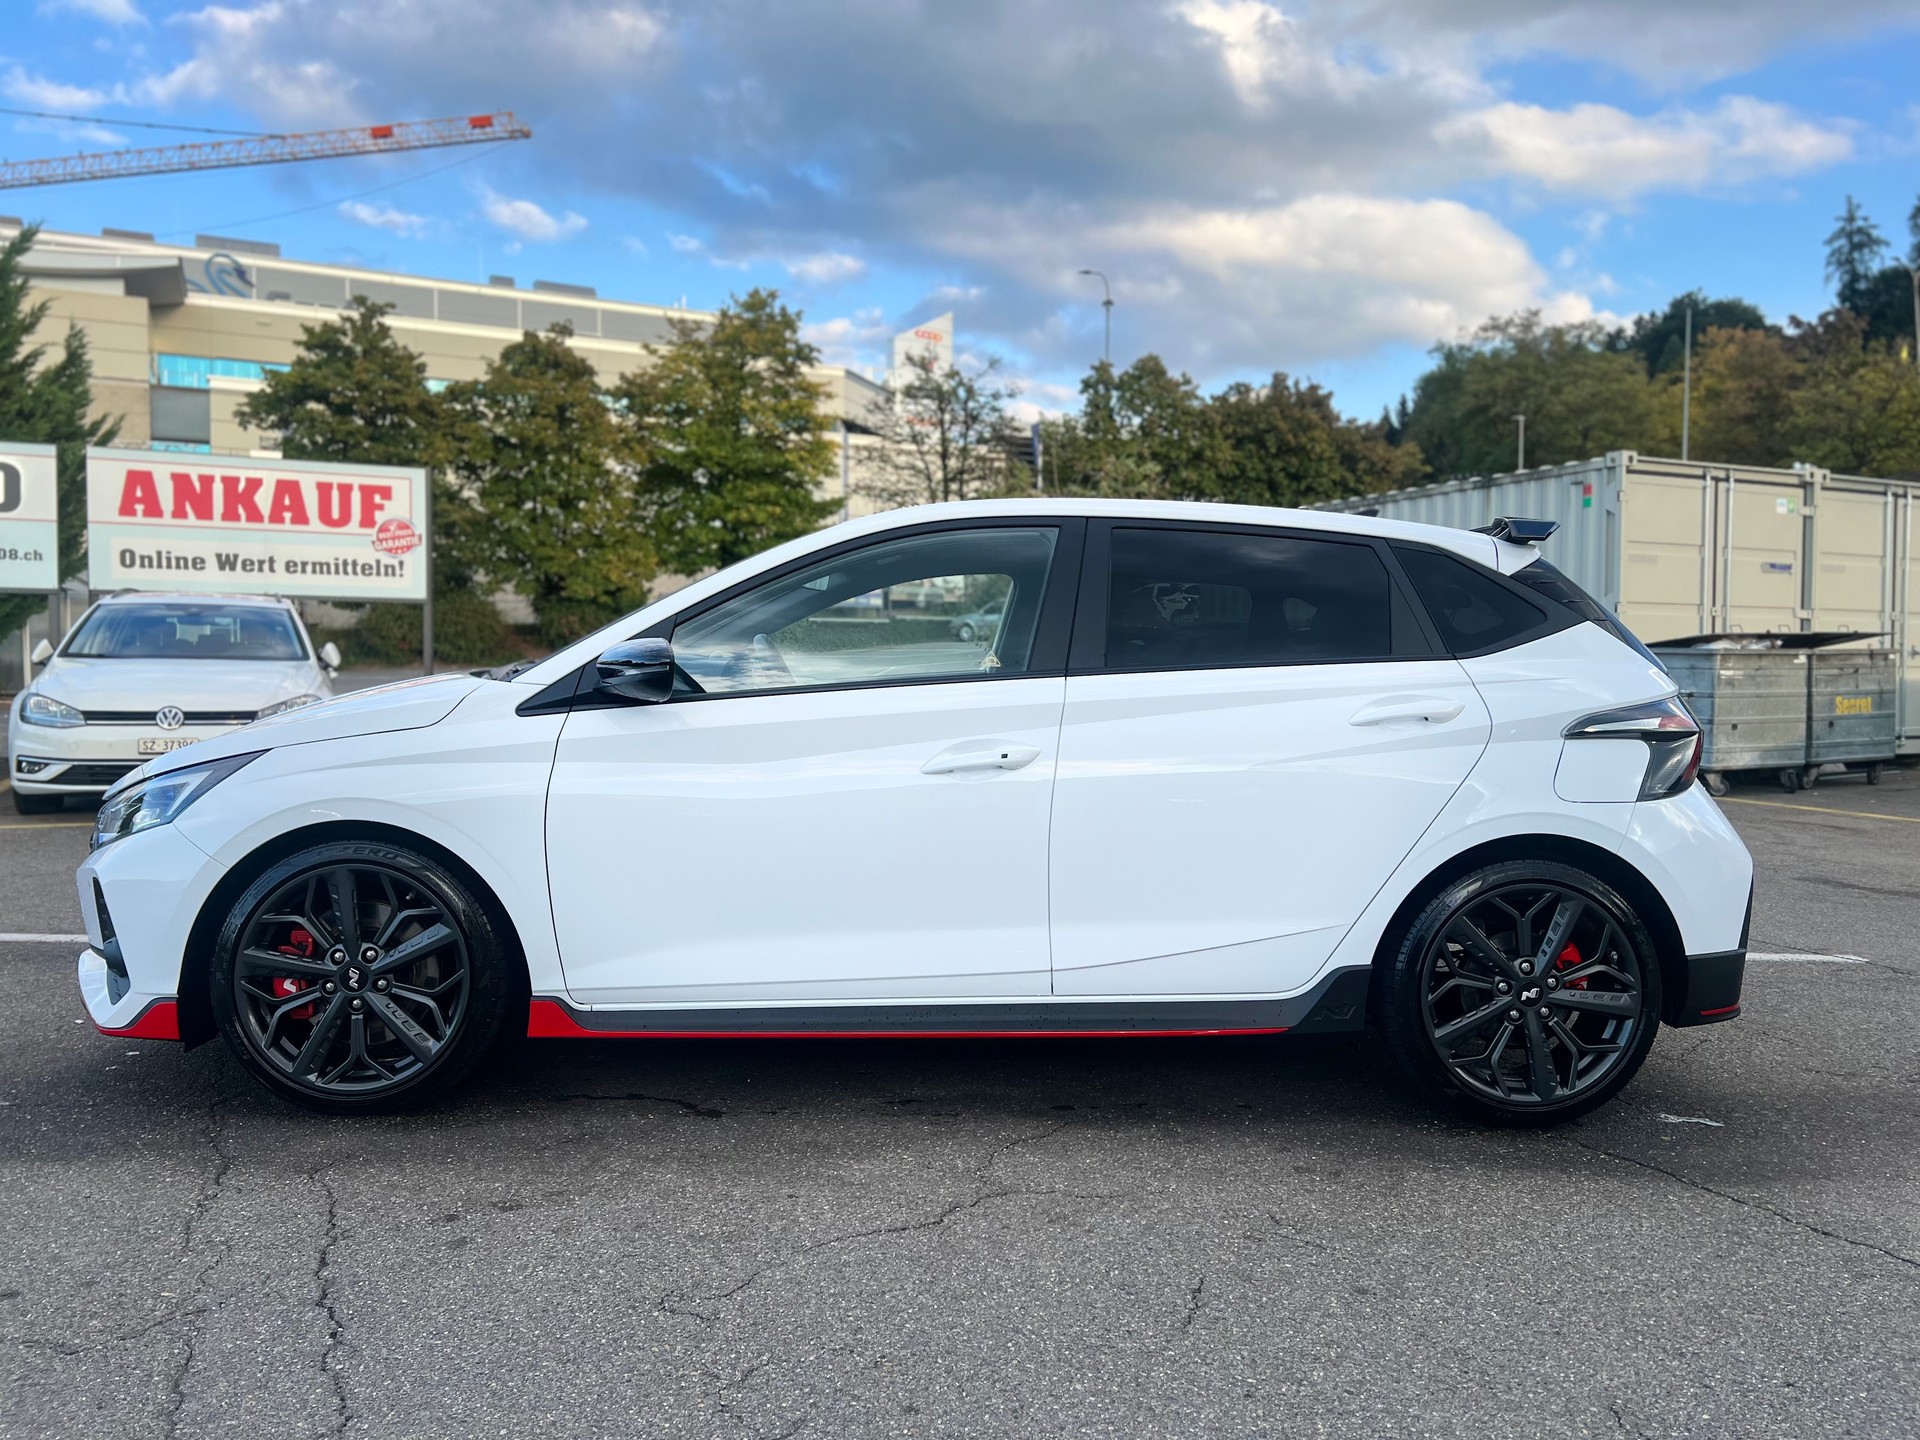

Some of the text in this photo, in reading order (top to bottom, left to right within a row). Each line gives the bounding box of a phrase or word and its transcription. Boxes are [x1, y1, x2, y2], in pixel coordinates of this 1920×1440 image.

[118, 469, 392, 529] ANKAUF
[119, 548, 405, 578] Online Wert ermitteln!
[1835, 695, 1873, 716] Secret
[142, 740, 156, 752] SZ
